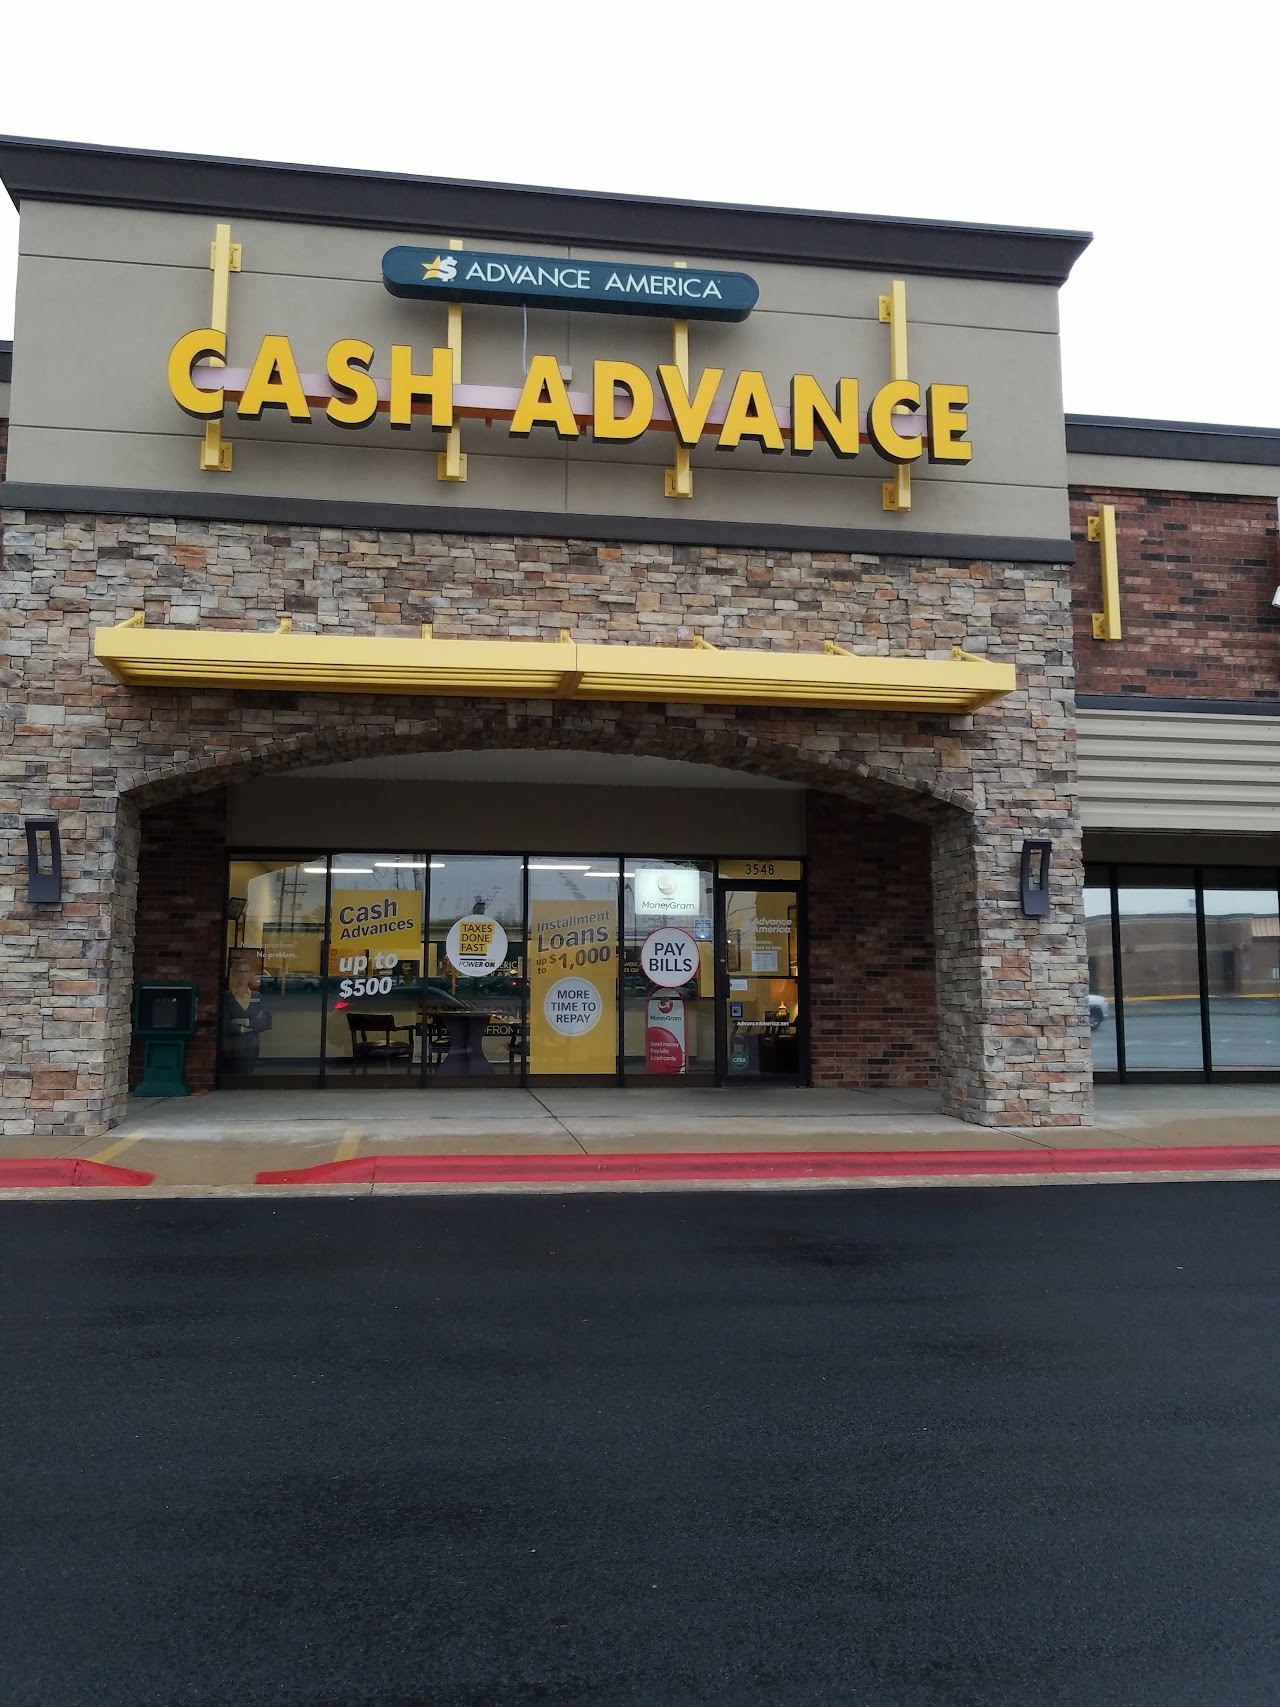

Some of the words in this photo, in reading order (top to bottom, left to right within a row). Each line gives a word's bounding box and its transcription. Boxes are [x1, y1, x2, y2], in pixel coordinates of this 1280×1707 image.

[465, 261, 591, 290] ADVANCE
[605, 272, 723, 300] AMERICA
[168, 328, 454, 432] CASH
[509, 354, 973, 465] ADVANCE
[745, 863, 775, 875] 3548
[339, 898, 397, 925] Cash
[641, 901, 695, 911] MoneyGram
[462, 923, 493, 933] TAXES
[537, 910, 610, 932] Installment
[753, 917, 792, 926] Advance
[340, 918, 414, 940] Advances
[461, 933, 490, 943] DONE
[537, 925, 609, 953] Loans
[461, 943, 485, 952] FAST
[654, 942, 686, 956] PAY
[339, 955, 368, 975] up
[375, 951, 398, 969] to
[536, 958, 547, 966] up
[549, 945, 611, 970] $1,000
[649, 958, 693, 972] BILLS
[339, 976, 392, 999] $500
[557, 989, 590, 999] MORE
[551, 1002, 578, 1011] TIME
[581, 1002, 596, 1012] TO
[556, 1013, 591, 1023] REPAY
[649, 1014, 682, 1022] MoneyGram
